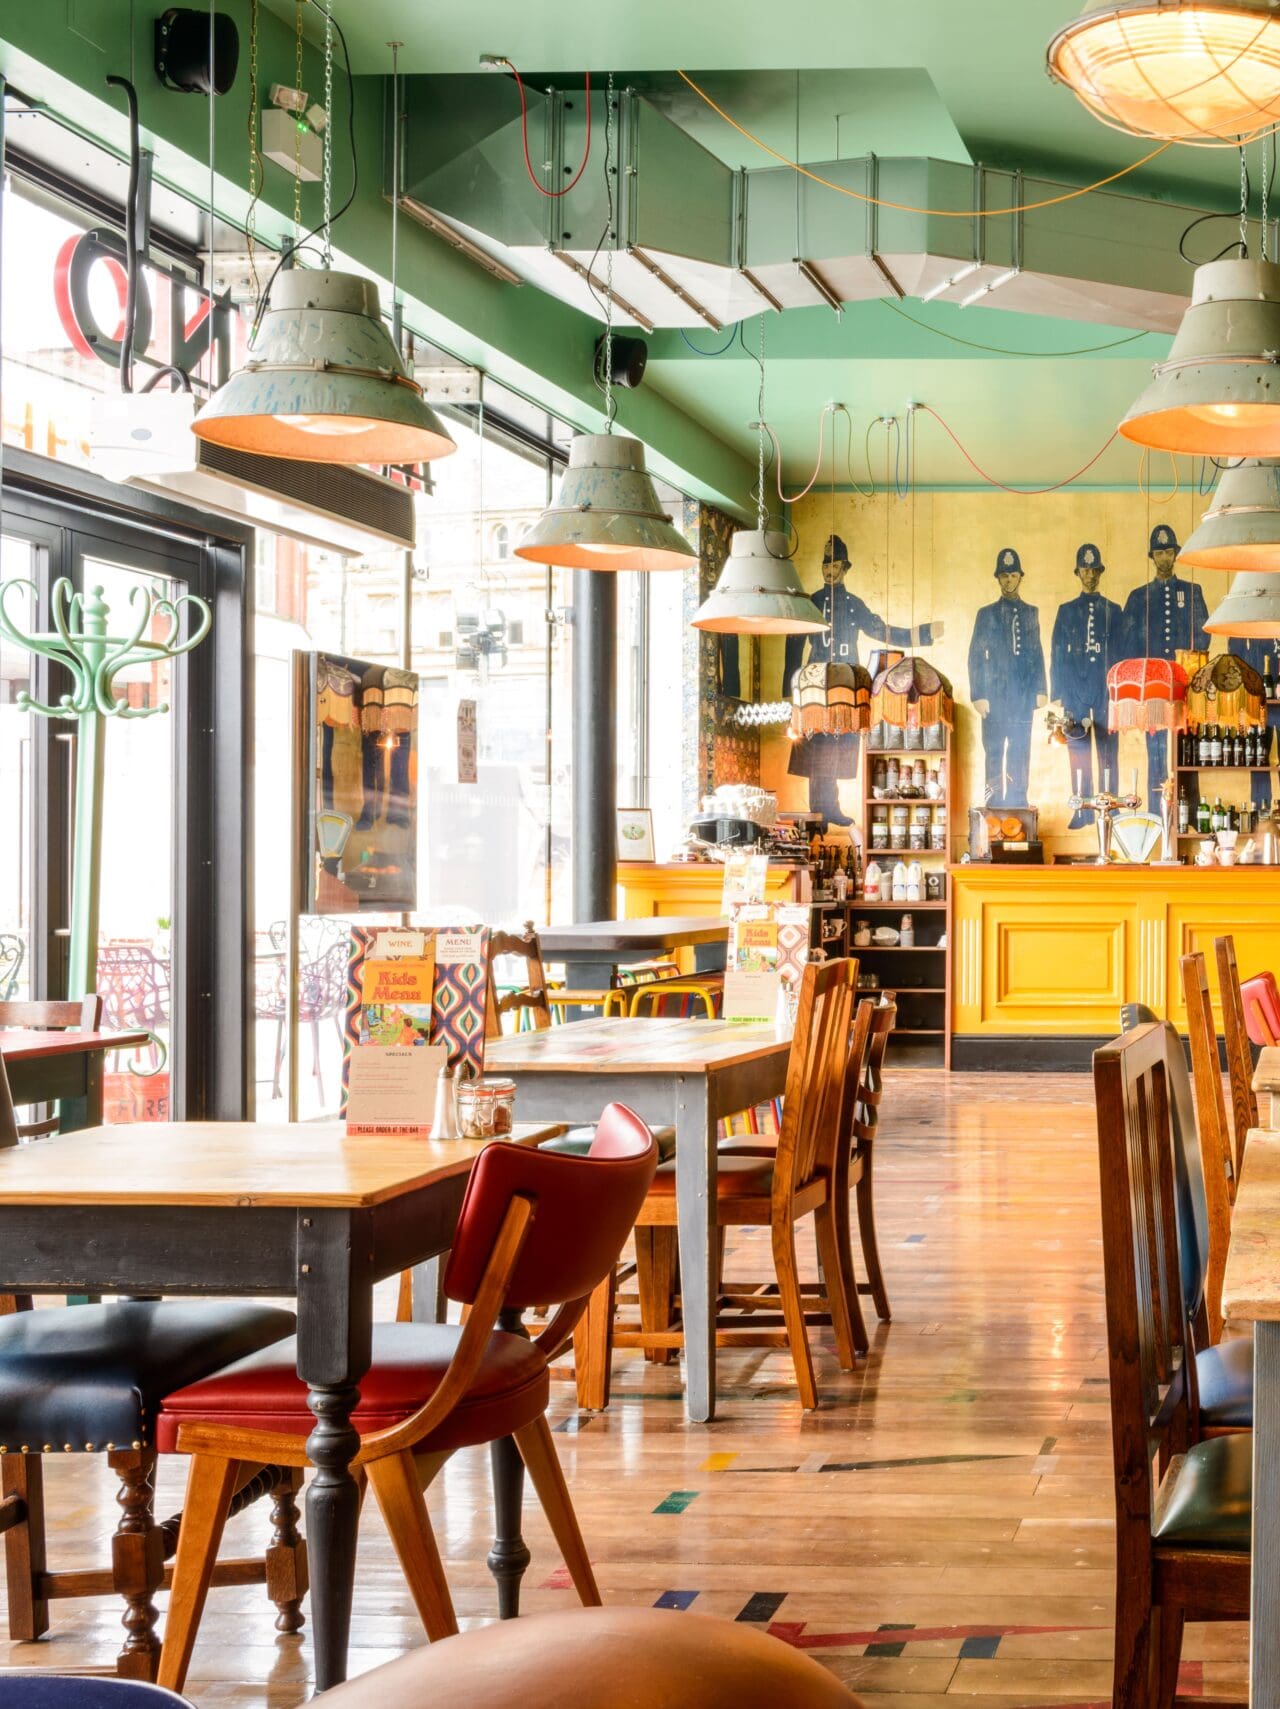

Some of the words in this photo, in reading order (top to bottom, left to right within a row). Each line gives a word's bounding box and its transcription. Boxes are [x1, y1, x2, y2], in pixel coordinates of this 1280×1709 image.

[746, 928, 769, 938] Kids
[388, 940, 413, 948] WINE
[445, 938, 472, 946] MENU
[378, 971, 417, 986] Kids
[372, 986, 422, 1001] Menu
